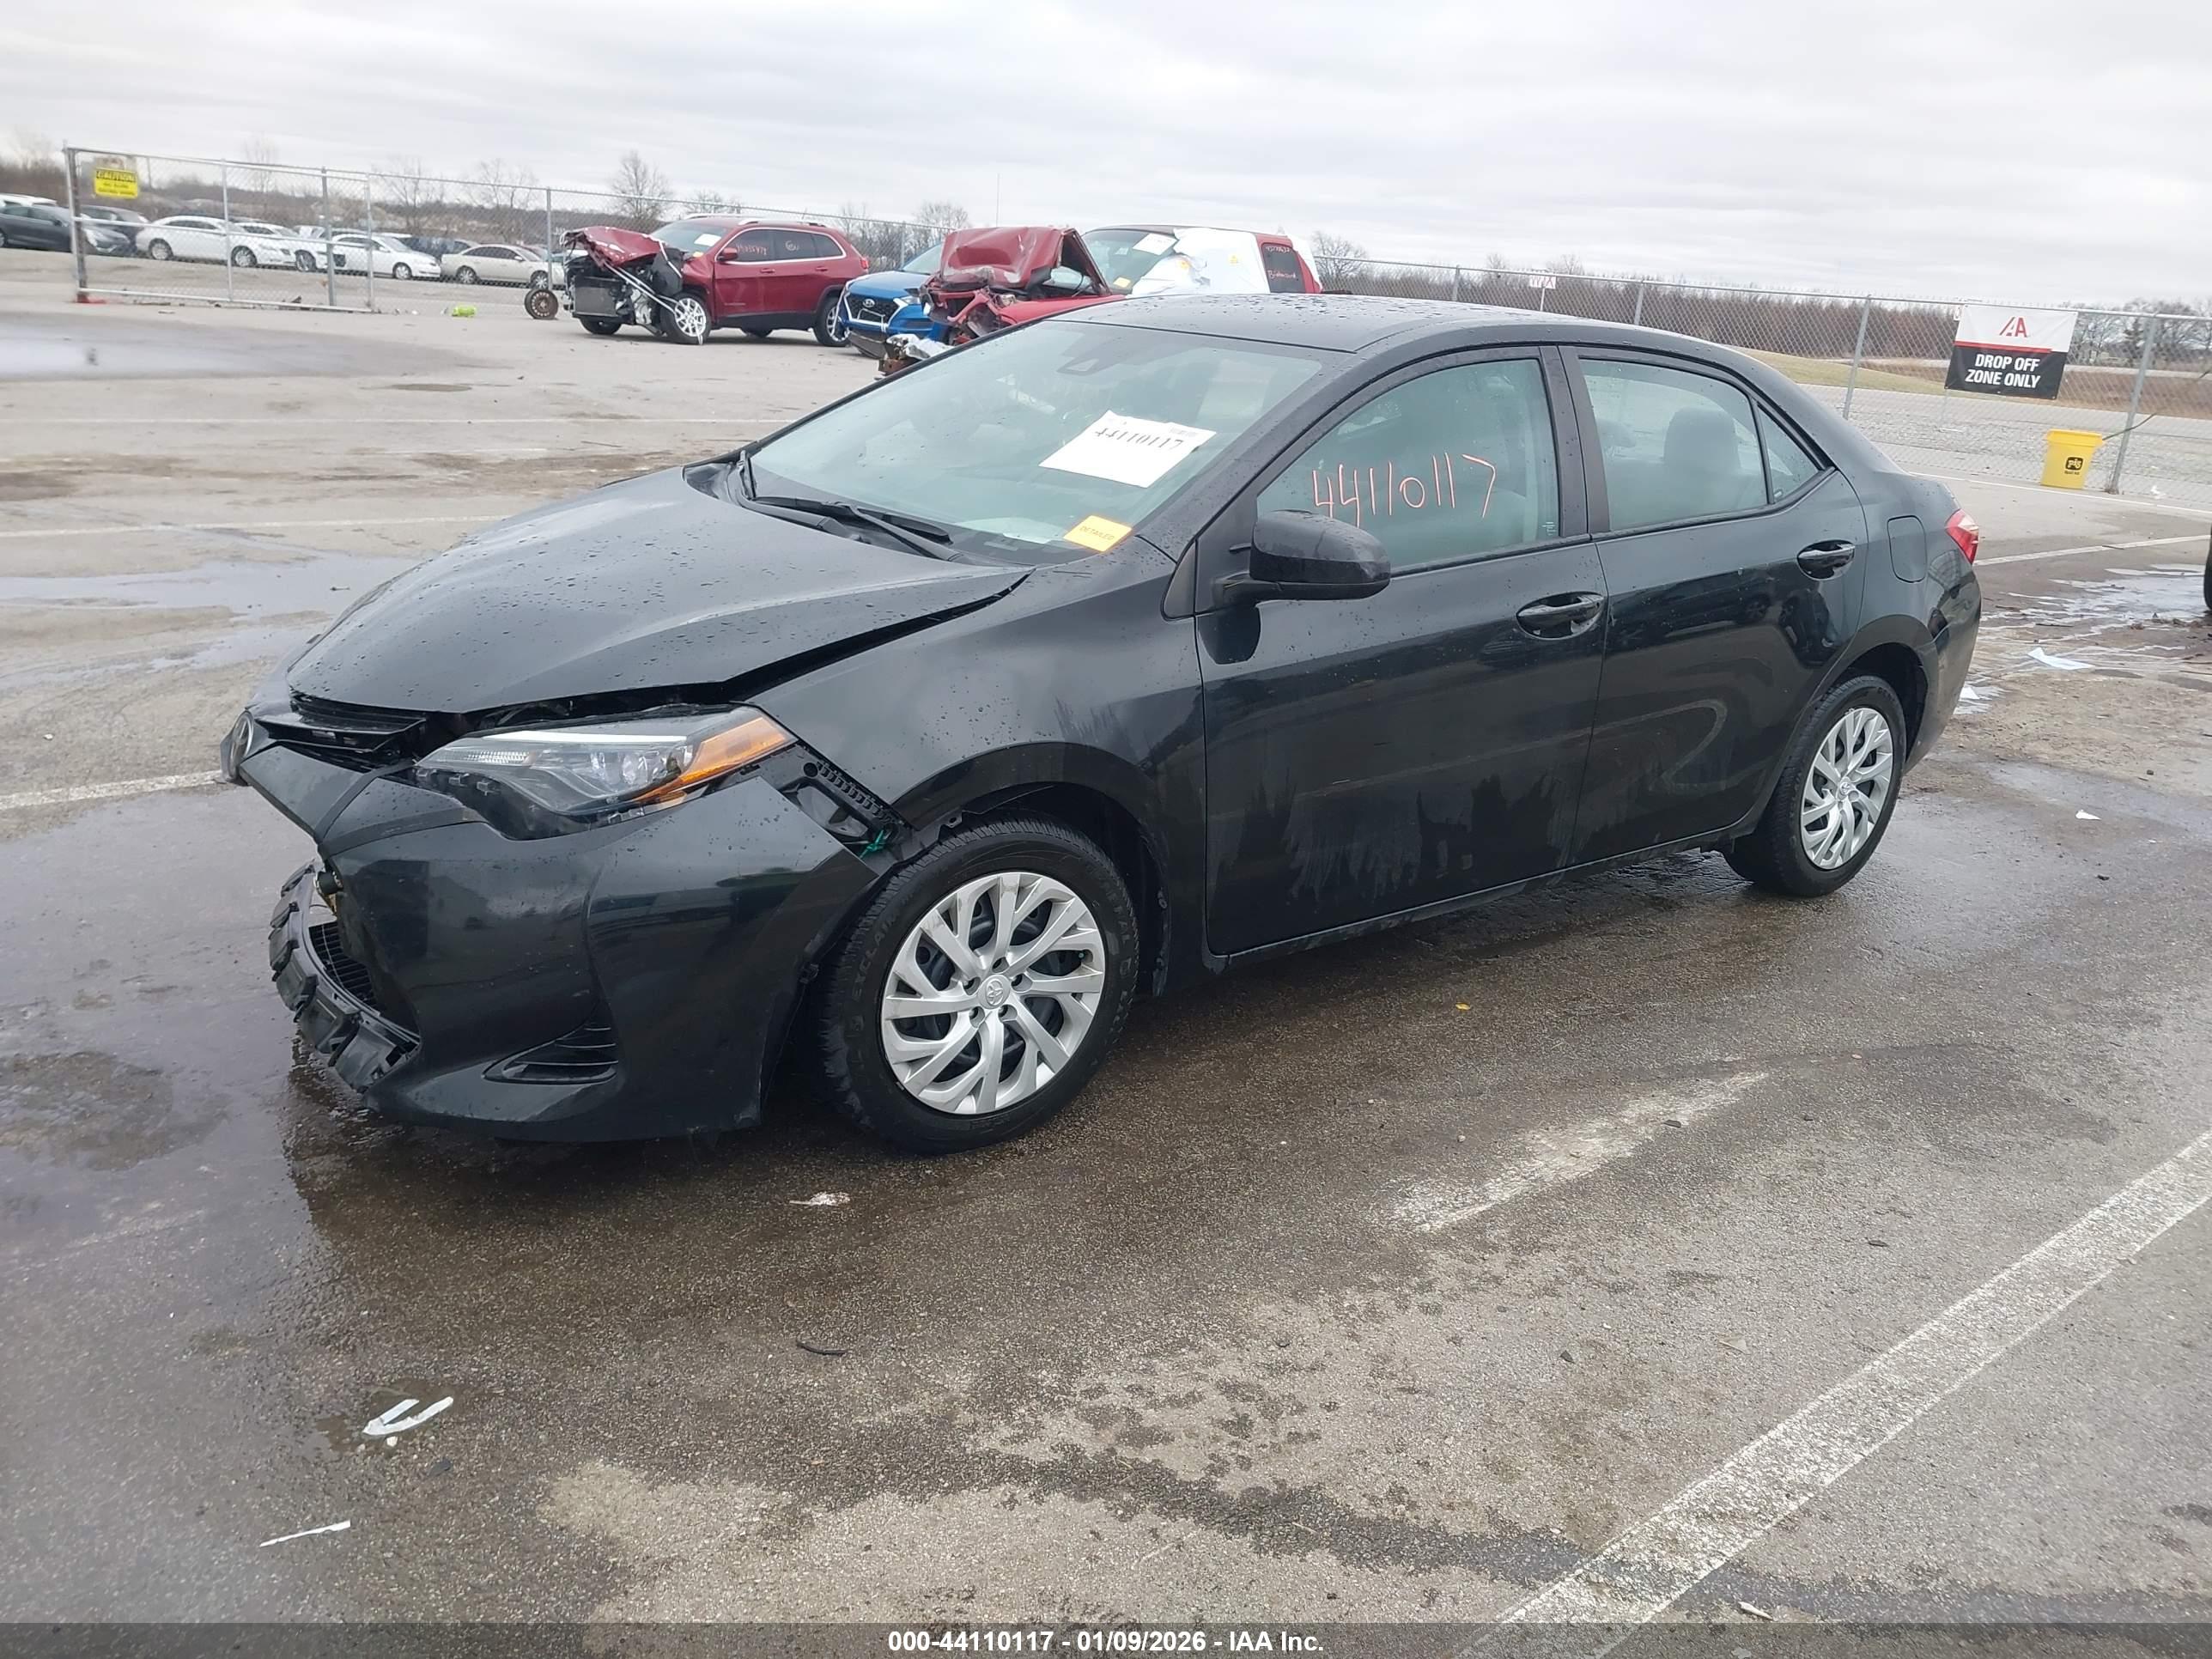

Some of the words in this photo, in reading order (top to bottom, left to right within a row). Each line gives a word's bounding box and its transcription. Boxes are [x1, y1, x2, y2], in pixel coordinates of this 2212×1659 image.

[1975, 354, 2011, 369] DROP
[2014, 357, 2040, 372] OFF
[1965, 369, 2002, 386] ZONE
[2004, 373, 2040, 388] ONLY
[1095, 428, 1184, 451] 44110117
[1312, 452, 1496, 528] 44110117
[1079, 526, 1115, 541] DETAILED
